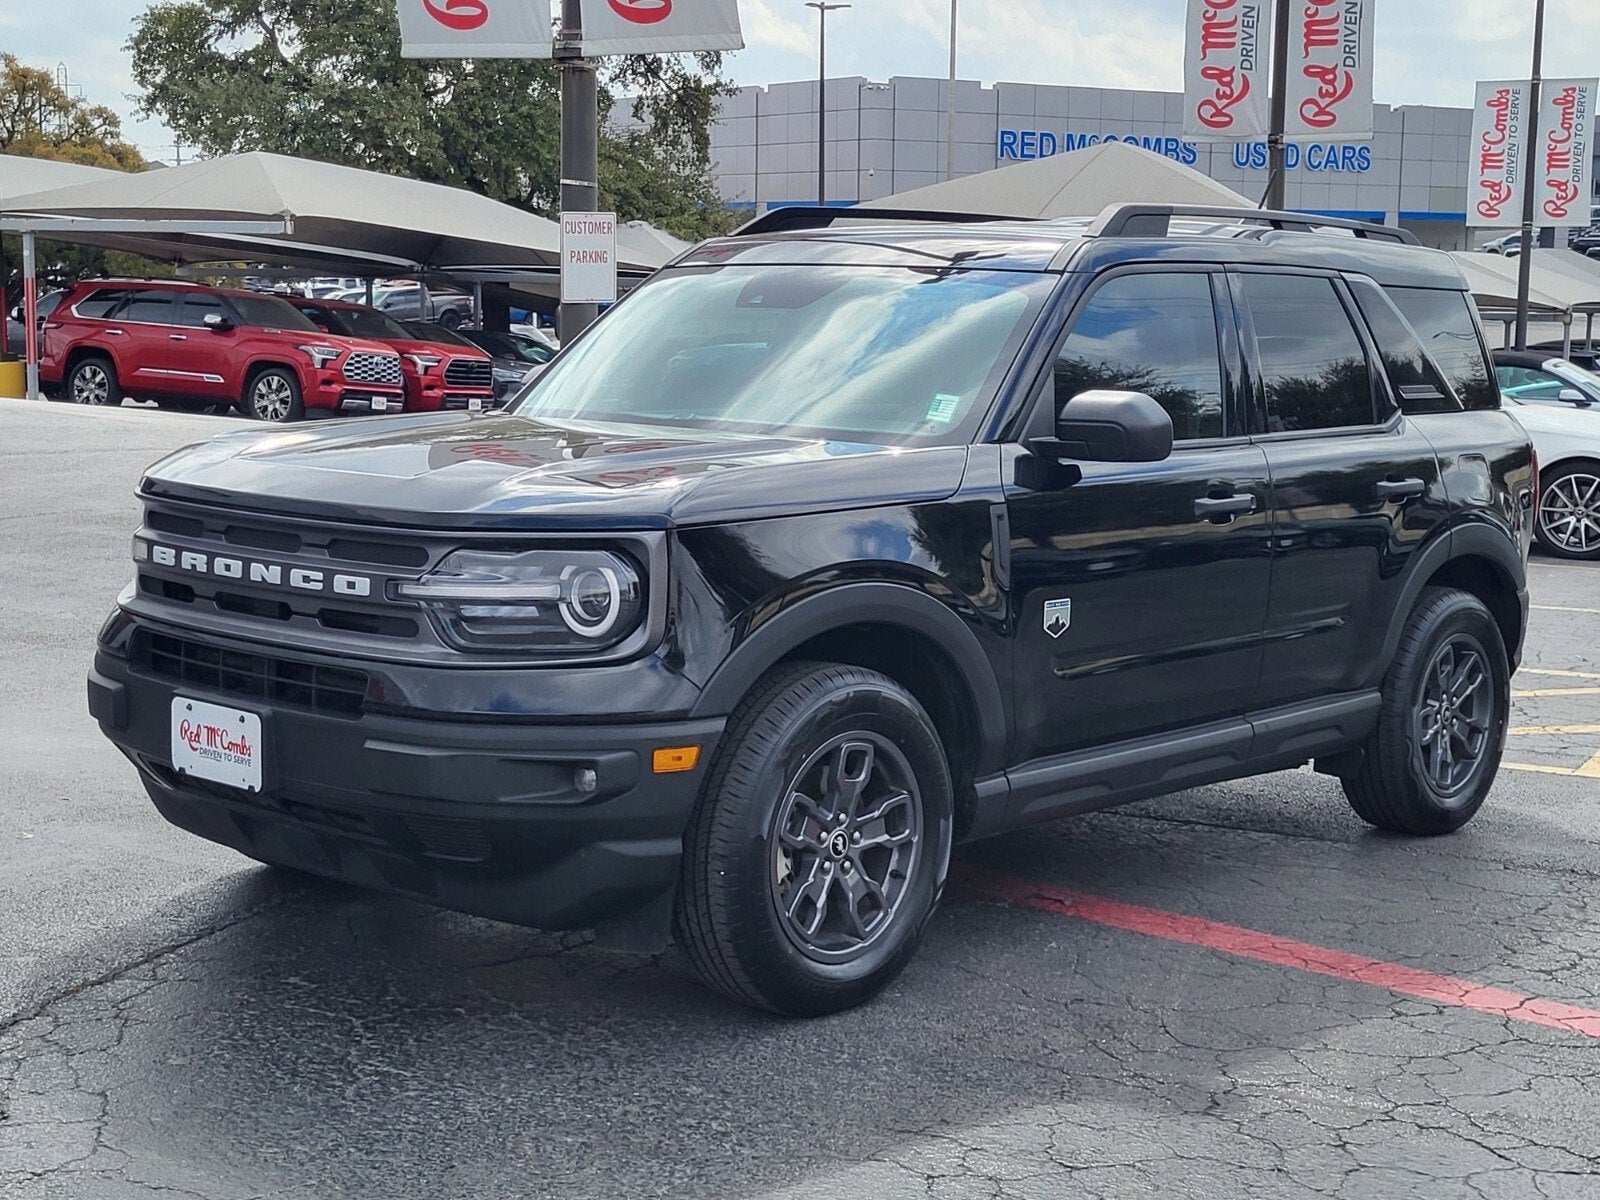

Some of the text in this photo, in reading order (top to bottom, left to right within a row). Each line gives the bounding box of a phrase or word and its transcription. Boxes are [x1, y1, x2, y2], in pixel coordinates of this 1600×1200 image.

[1240, 5, 1256, 71] DRIVEN
[1342, 2, 1358, 68] DRIVEN
[1197, 66, 1250, 128] Red
[1299, 63, 1353, 128] Red
[999, 129, 1058, 159] RED
[1232, 142, 1300, 169] USD
[1305, 144, 1372, 172] CARS
[1476, 88, 1512, 218] Red McCombs
[1505, 88, 1521, 184] DRIVEN TO SERVE
[1543, 87, 1578, 218] Red McCombs
[1571, 86, 1588, 183] DRIVEN TO SERVE
[564, 221, 613, 235] CUSTOMER
[570, 250, 608, 264] PARKING
[152, 545, 371, 597] BRONCO
[180, 718, 252, 758] Red McCombs
[199, 747, 252, 768] DRIVEN TO SERVE
